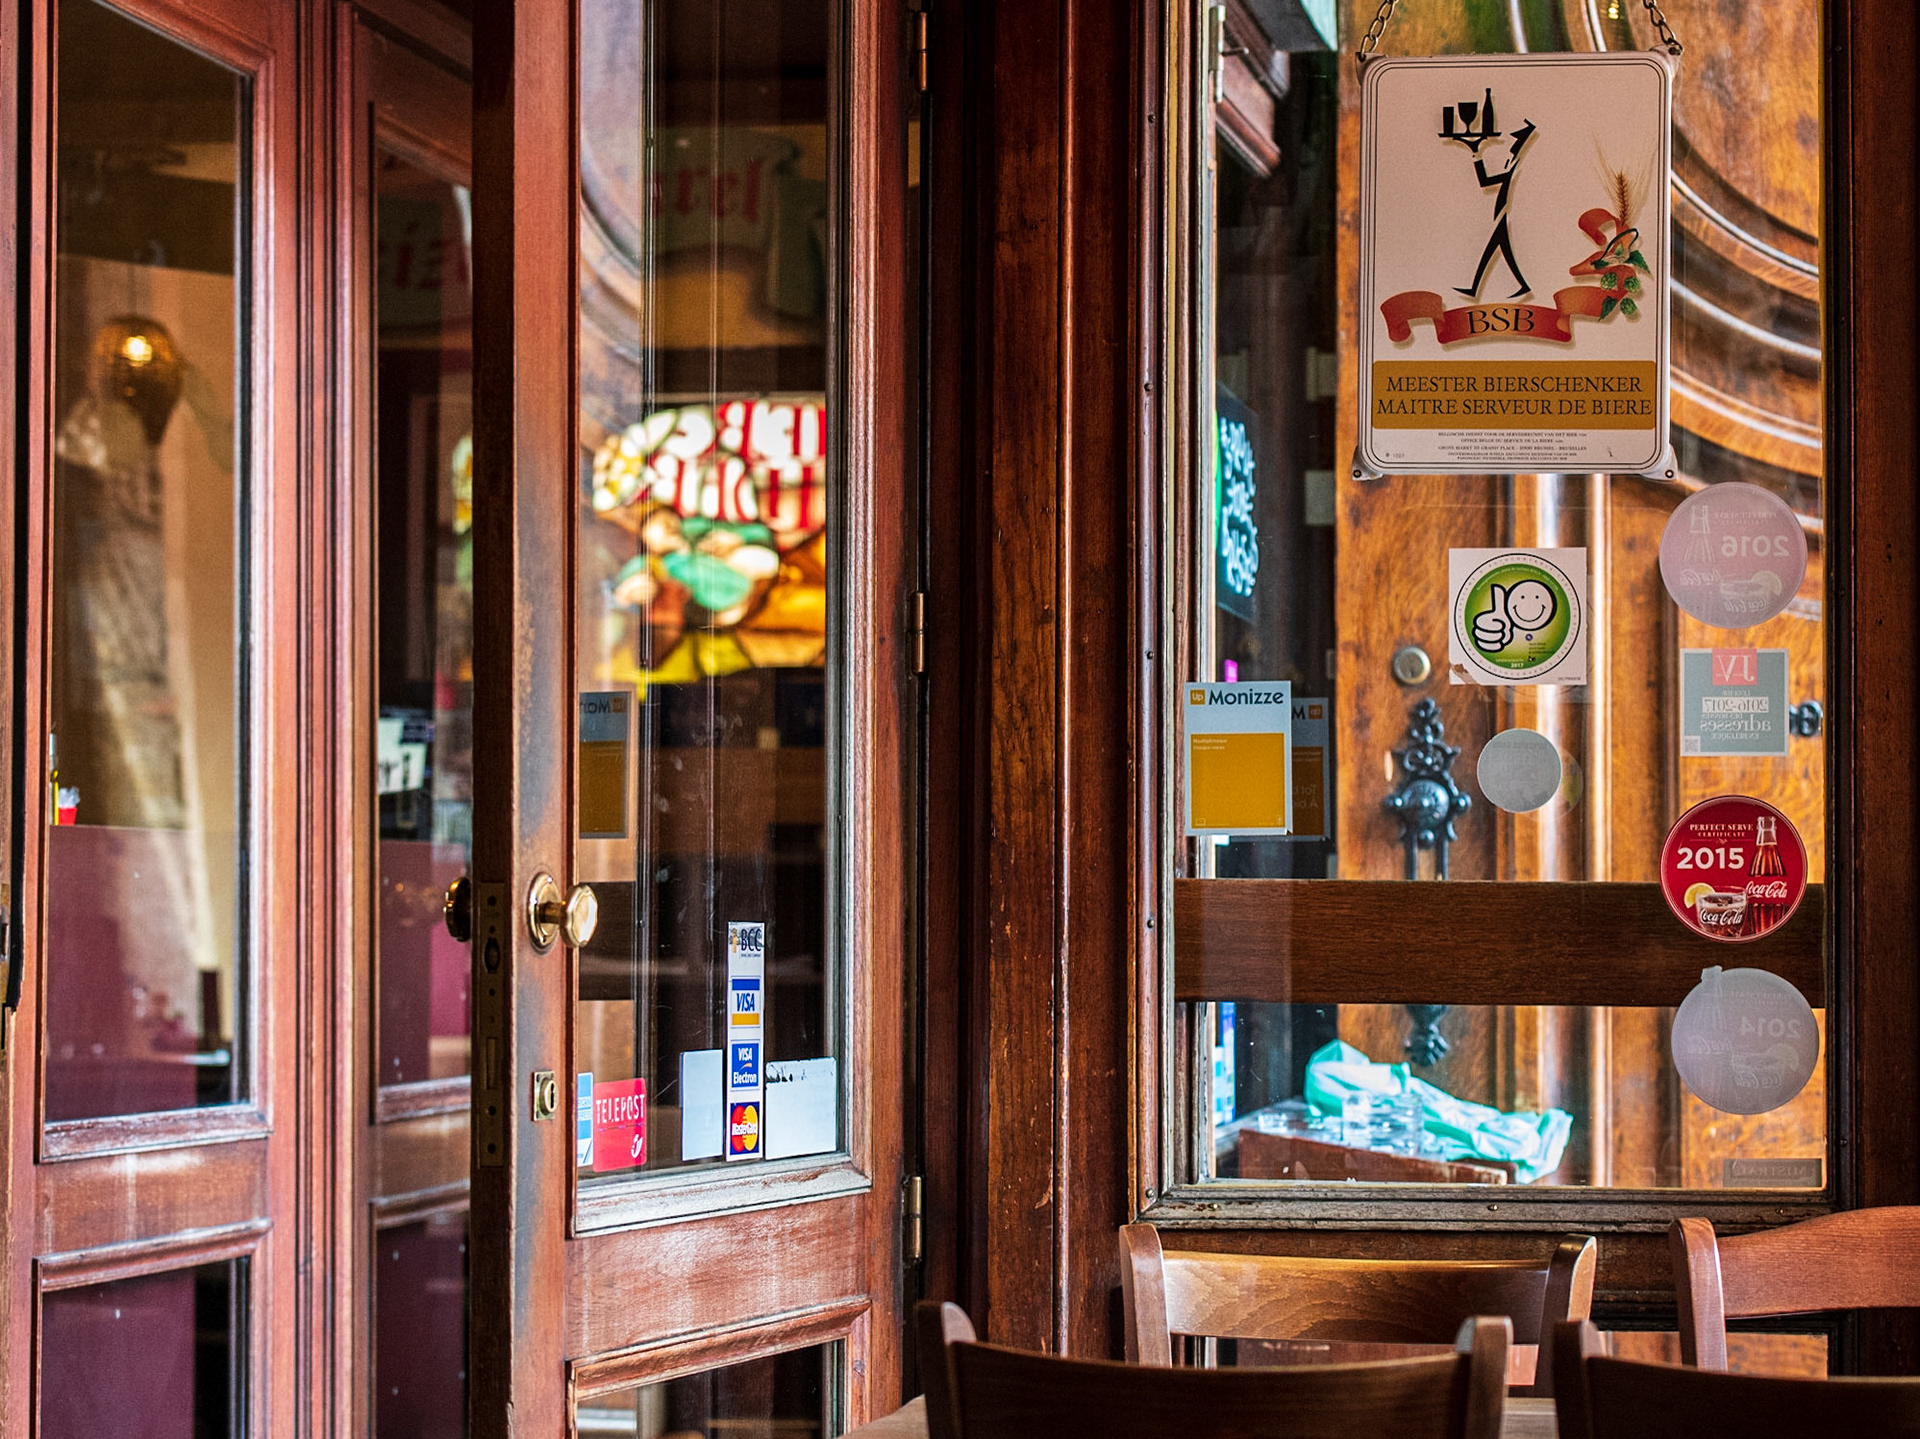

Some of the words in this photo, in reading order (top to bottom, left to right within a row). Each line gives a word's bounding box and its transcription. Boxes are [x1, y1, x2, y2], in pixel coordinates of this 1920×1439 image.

[1467, 307, 1535, 335] BSB
[1386, 376, 1479, 393] MEESTER
[1484, 376, 1642, 393] BIERSCHENKER
[1377, 398, 1458, 415] MAITRE
[1463, 398, 1553, 415] SERVEUR
[1558, 398, 1587, 415] DE
[1591, 398, 1652, 415] BIERE
[1208, 688, 1284, 706] Monizze
[1689, 823, 1726, 831] PERFECT
[1727, 823, 1754, 831] SERVE
[1676, 847, 1744, 870] 2015
[1746, 880, 1788, 899] Coca-Cola
[1699, 907, 1743, 926] Coca-Cola
[741, 928, 762, 952] BCC
[736, 992, 755, 1012] VISA
[738, 1048, 752, 1061] VISA
[733, 1071, 757, 1085] Electron
[595, 1094, 645, 1124] TELEPOST
